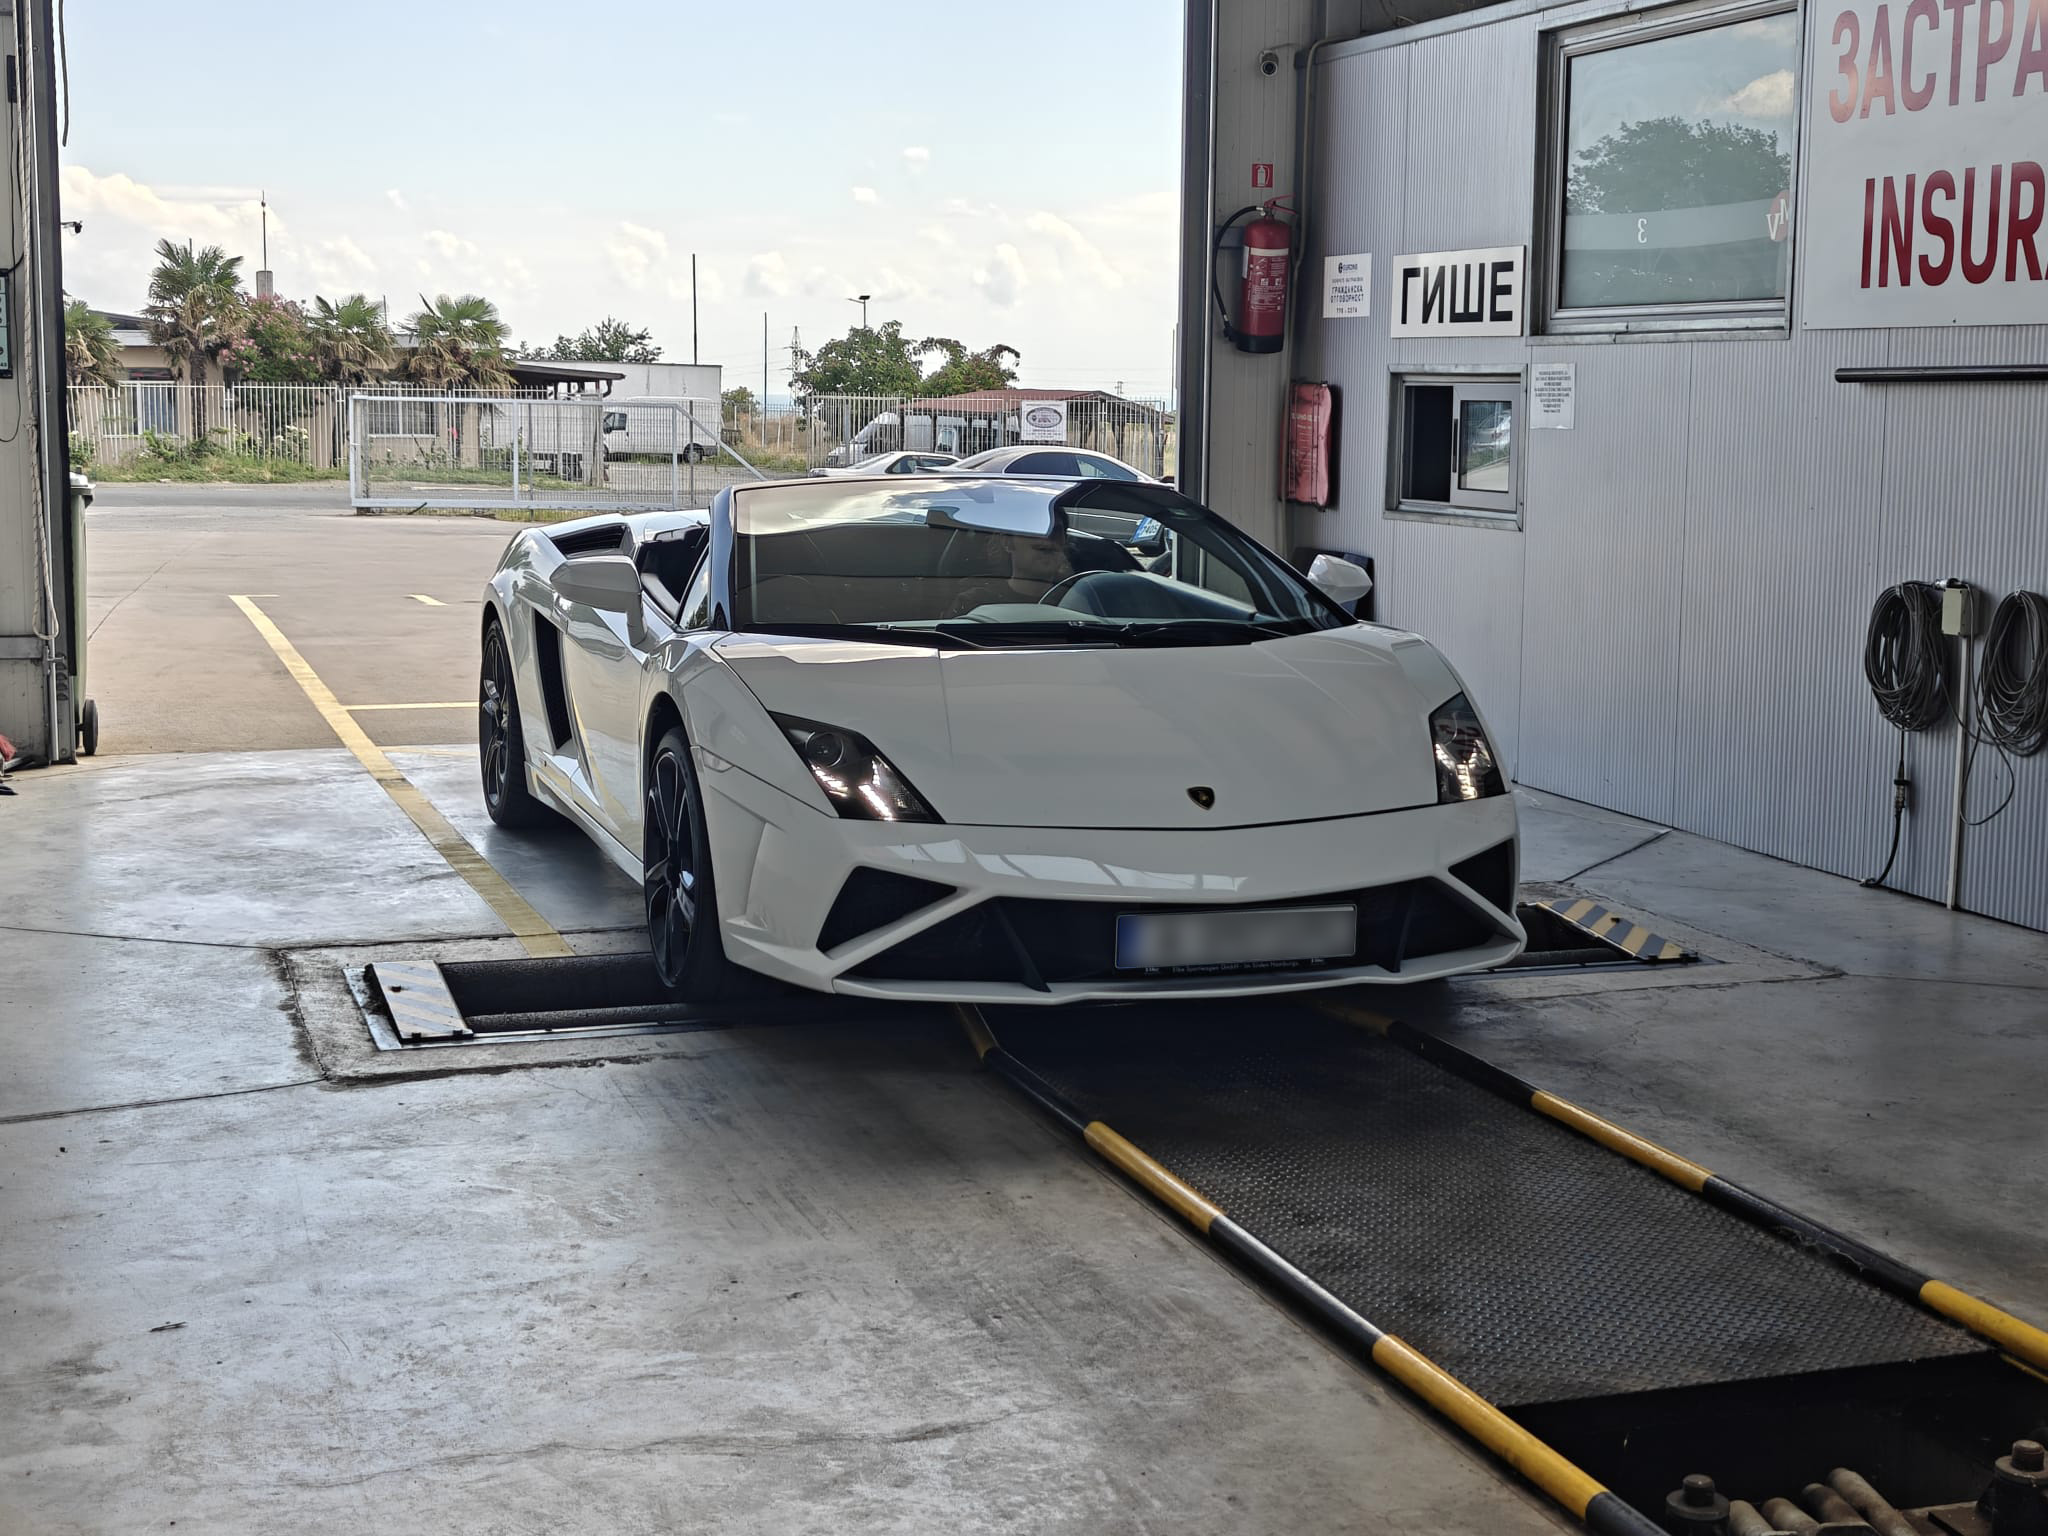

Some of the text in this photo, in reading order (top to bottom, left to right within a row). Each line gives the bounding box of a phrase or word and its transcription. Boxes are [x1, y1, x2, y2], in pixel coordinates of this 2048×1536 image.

[1829, 0, 2048, 123] ЗАСТРА
[1861, 161, 2048, 288] INSUR
[1401, 261, 1514, 325] ГИШЕ
